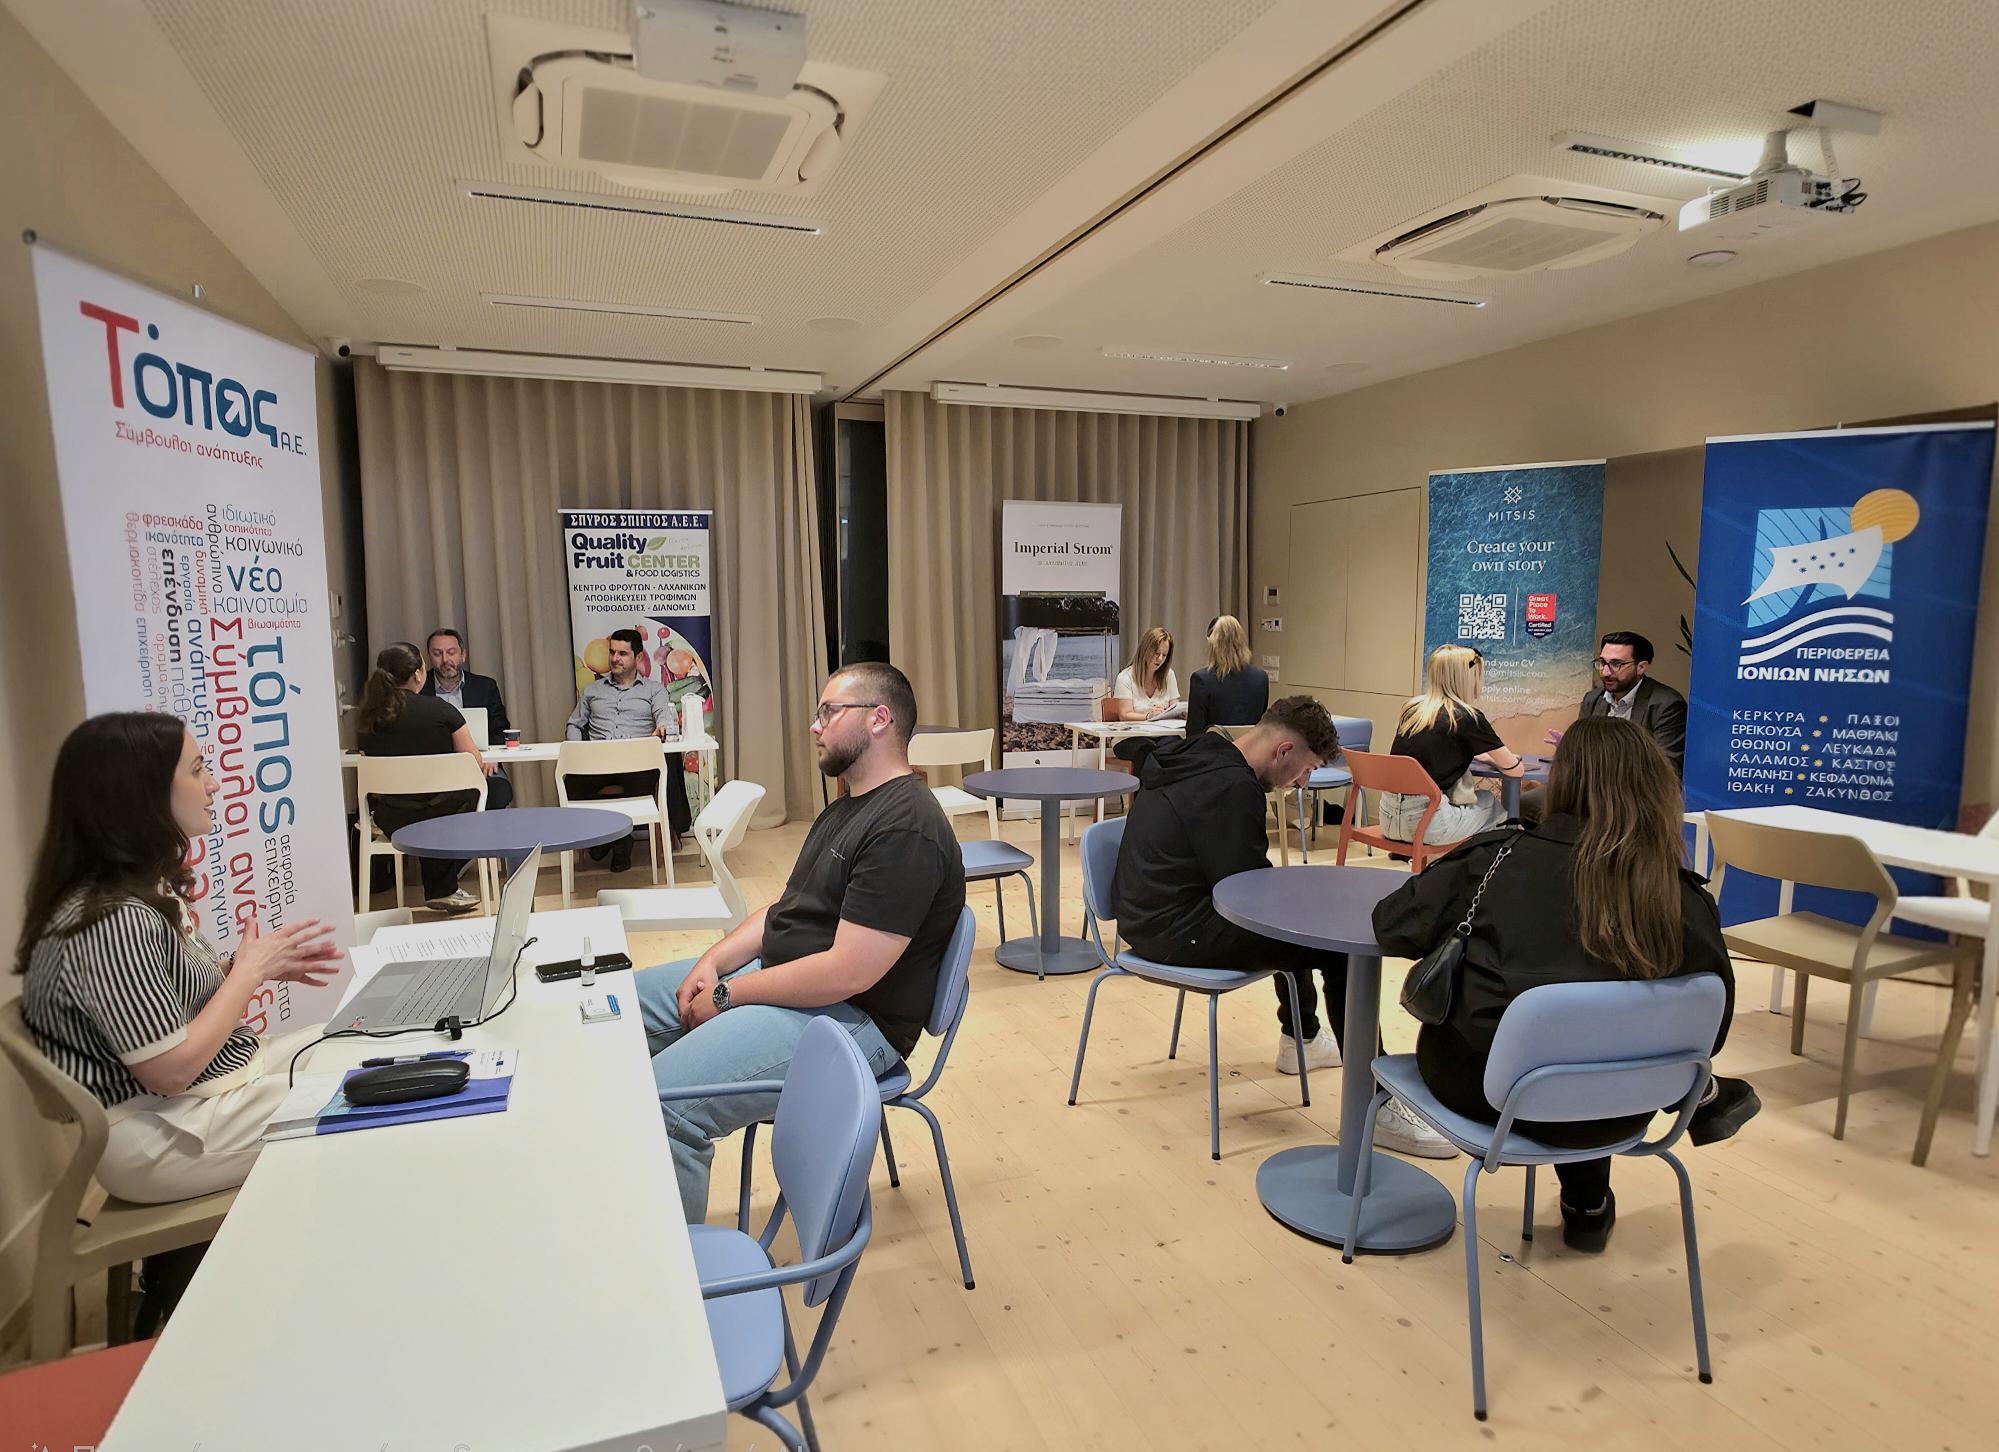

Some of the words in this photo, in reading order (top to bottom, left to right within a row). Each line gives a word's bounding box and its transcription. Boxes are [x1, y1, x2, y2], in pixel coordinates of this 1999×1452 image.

[80, 301, 278, 448] Τόπος
[115, 421, 192, 455] Σύμβουλοι
[196, 441, 264, 469] ανάπτυξης
[142, 513, 204, 531] φρεσκάδα
[222, 503, 276, 526] ιδιωτικό
[571, 514, 617, 527] ΣΠΥΡΟΣ
[620, 514, 668, 527] ΣΠΙΓΓΟΣ
[671, 515, 703, 527] Α.Ε.Ε.
[1488, 510, 1536, 523] MITSIS
[145, 530, 204, 547] ικανότητα
[224, 523, 273, 536] τοπικότητα
[206, 503, 224, 593] ανθρώπινο
[225, 536, 303, 556] κοινωνικό
[571, 533, 647, 554] Quality
[1014, 541, 1069, 557] Imperial
[1466, 540, 1516, 554] Create
[1518, 540, 1555, 555] your
[573, 552, 625, 569] Fruit
[627, 554, 700, 569] CENTER
[1472, 562, 1504, 572] own
[1507, 558, 1547, 574] story
[195, 550, 211, 615] δυναμική
[226, 555, 283, 593] νέο
[626, 569, 633, 577] &
[634, 569, 659, 577] FOOD
[661, 569, 700, 578] LOGISTICS
[180, 555, 195, 611] εργασία
[573, 583, 606, 592] ΚΕΝΤΡΟ
[609, 583, 650, 591] ΦΡΟΥΤΩΝ
[658, 583, 706, 591] ΛΑΧΑΝΙΚΩΝ
[161, 548, 182, 663] επένδυση
[213, 592, 308, 619] καινοτομία
[584, 594, 647, 602] ΑΠΟΘΗΚΕΥΣΕΙΣ
[650, 593, 697, 601] ΤΡΟΦΙΜΩΝ
[586, 604, 646, 612] ΤΡΟΦΟΔΟΣΙΕΣ
[652, 603, 696, 612] ΔΙΑΝΟΜΕΣ
[247, 618, 301, 630] βιωσιμότητα
[136, 617, 153, 698] επιχείρηση
[1796, 647, 1890, 661] ΠΕΡΙΦΕΡΕΙΑ
[1498, 660, 1519, 668] your
[1520, 659, 1535, 668] CV
[187, 619, 214, 738] ανάπτυξη
[1737, 666, 1810, 681] ΙΟΝΙΩΝ
[1813, 668, 1890, 684] ΝΗΣΩΝ
[1502, 684, 1532, 694] online
[1733, 710, 1805, 723] ΚΕΡΚΥΡΑ
[1847, 714, 1899, 726] ΠΑΞΟΙ
[206, 617, 255, 839] Σύμβουλοι
[247, 636, 301, 835] τόπος
[1731, 724, 1802, 738] ΕΡΕΙΚΟΥΣΑ
[1832, 728, 1898, 742] ΜΑΘΡΑΚΙ
[1730, 738, 1791, 752] ΟΘΩΝΟΙ
[1821, 743, 1897, 757] ΛΕΥΚΑΔΑ
[1729, 753, 1809, 767] ΚΑΛΑΜΟΣ
[1832, 758, 1896, 772] ΚΑΣΤΟΣ
[1728, 767, 1793, 781] ΜΕΓΑΝΗΣΙ
[1810, 771, 1895, 786] ΚΕΦΑΛΟΝΙΑ
[1727, 781, 1775, 795] ΙΘΑΚΗ
[1806, 785, 1894, 801] ΖΑΚΥΝΘΟΣ
[280, 834, 299, 906] αειφορία
